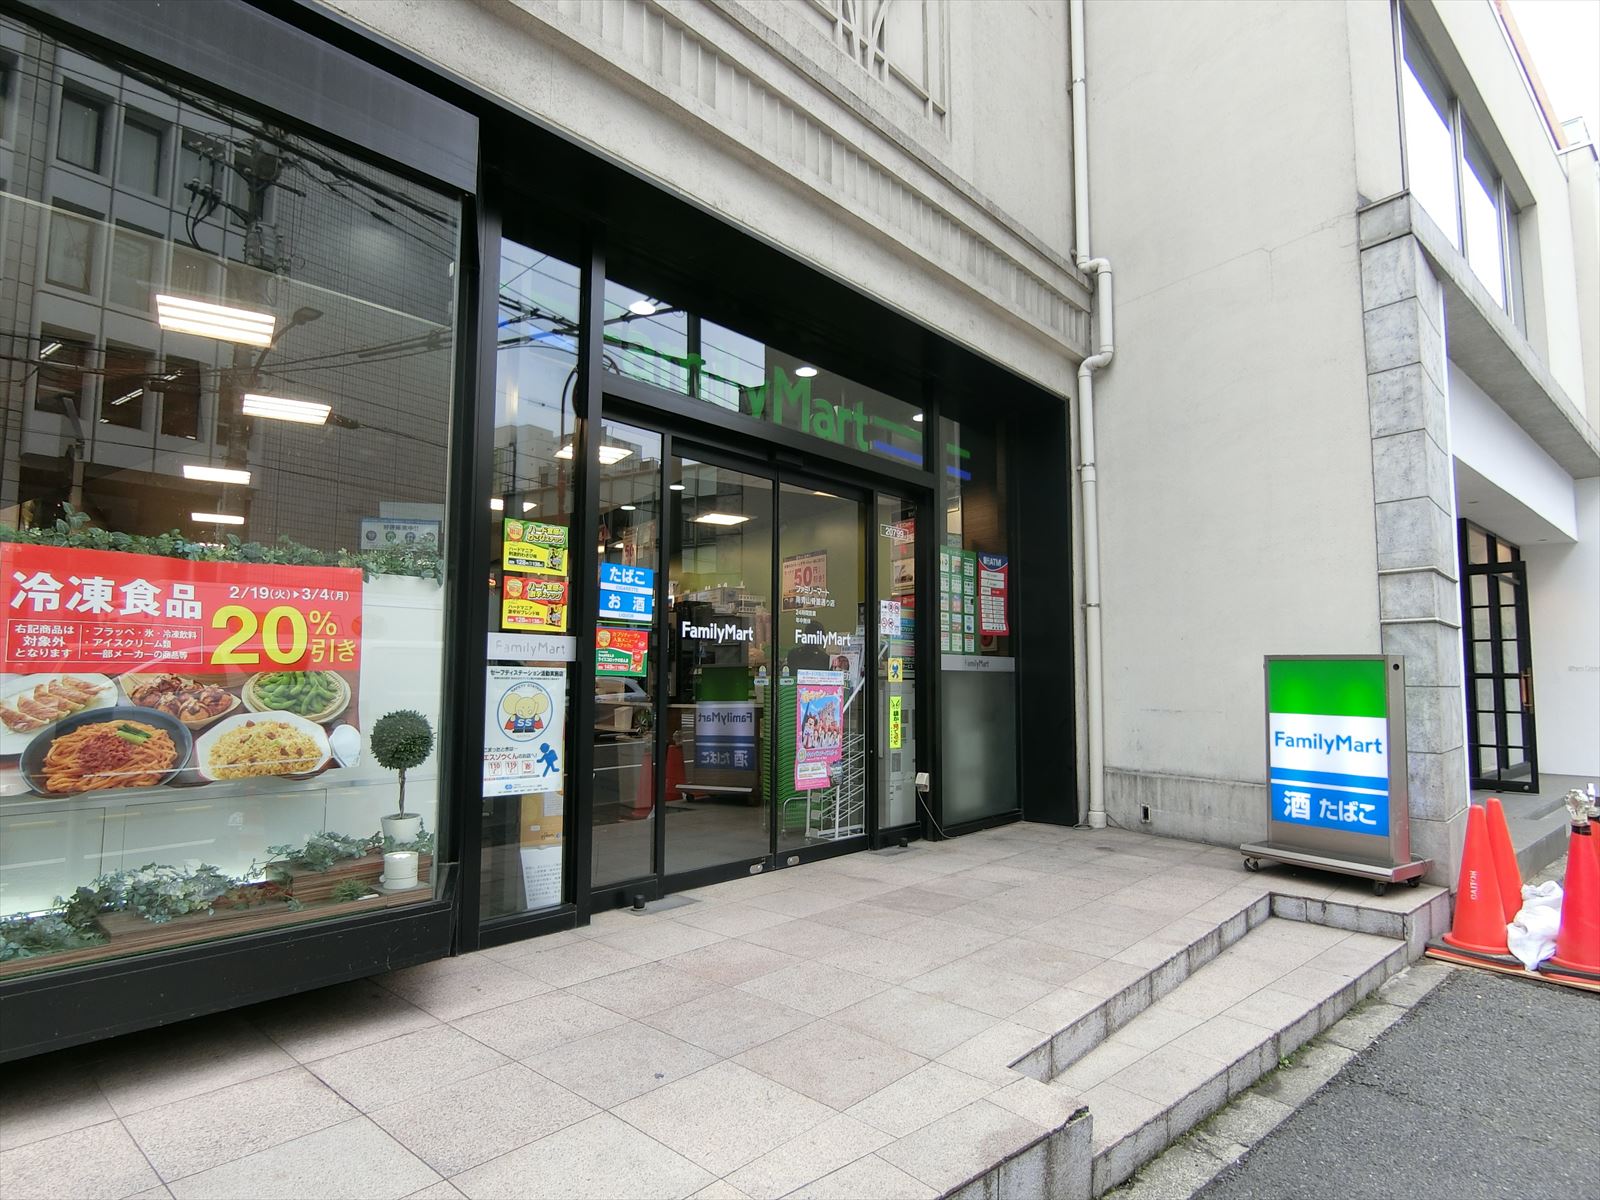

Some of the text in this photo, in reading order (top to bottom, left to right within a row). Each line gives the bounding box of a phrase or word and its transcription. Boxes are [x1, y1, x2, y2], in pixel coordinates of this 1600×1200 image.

[610, 566, 646, 585] たばこ
[10, 571, 202, 619] 冷凍食品
[796, 585, 830, 595] ファミリーマート
[608, 594, 645, 612] お 酒
[15, 624, 75, 634] 右記商品は
[682, 621, 754, 643] FamilyMart
[795, 629, 851, 648] FamilyMart
[23, 636, 66, 647] 対象外
[311, 639, 356, 663] 引き
[496, 640, 566, 656] FamilyMart
[15, 648, 72, 658] となります
[1274, 731, 1382, 755] FamilyMart
[1283, 790, 1377, 825] 酒 たばこ
